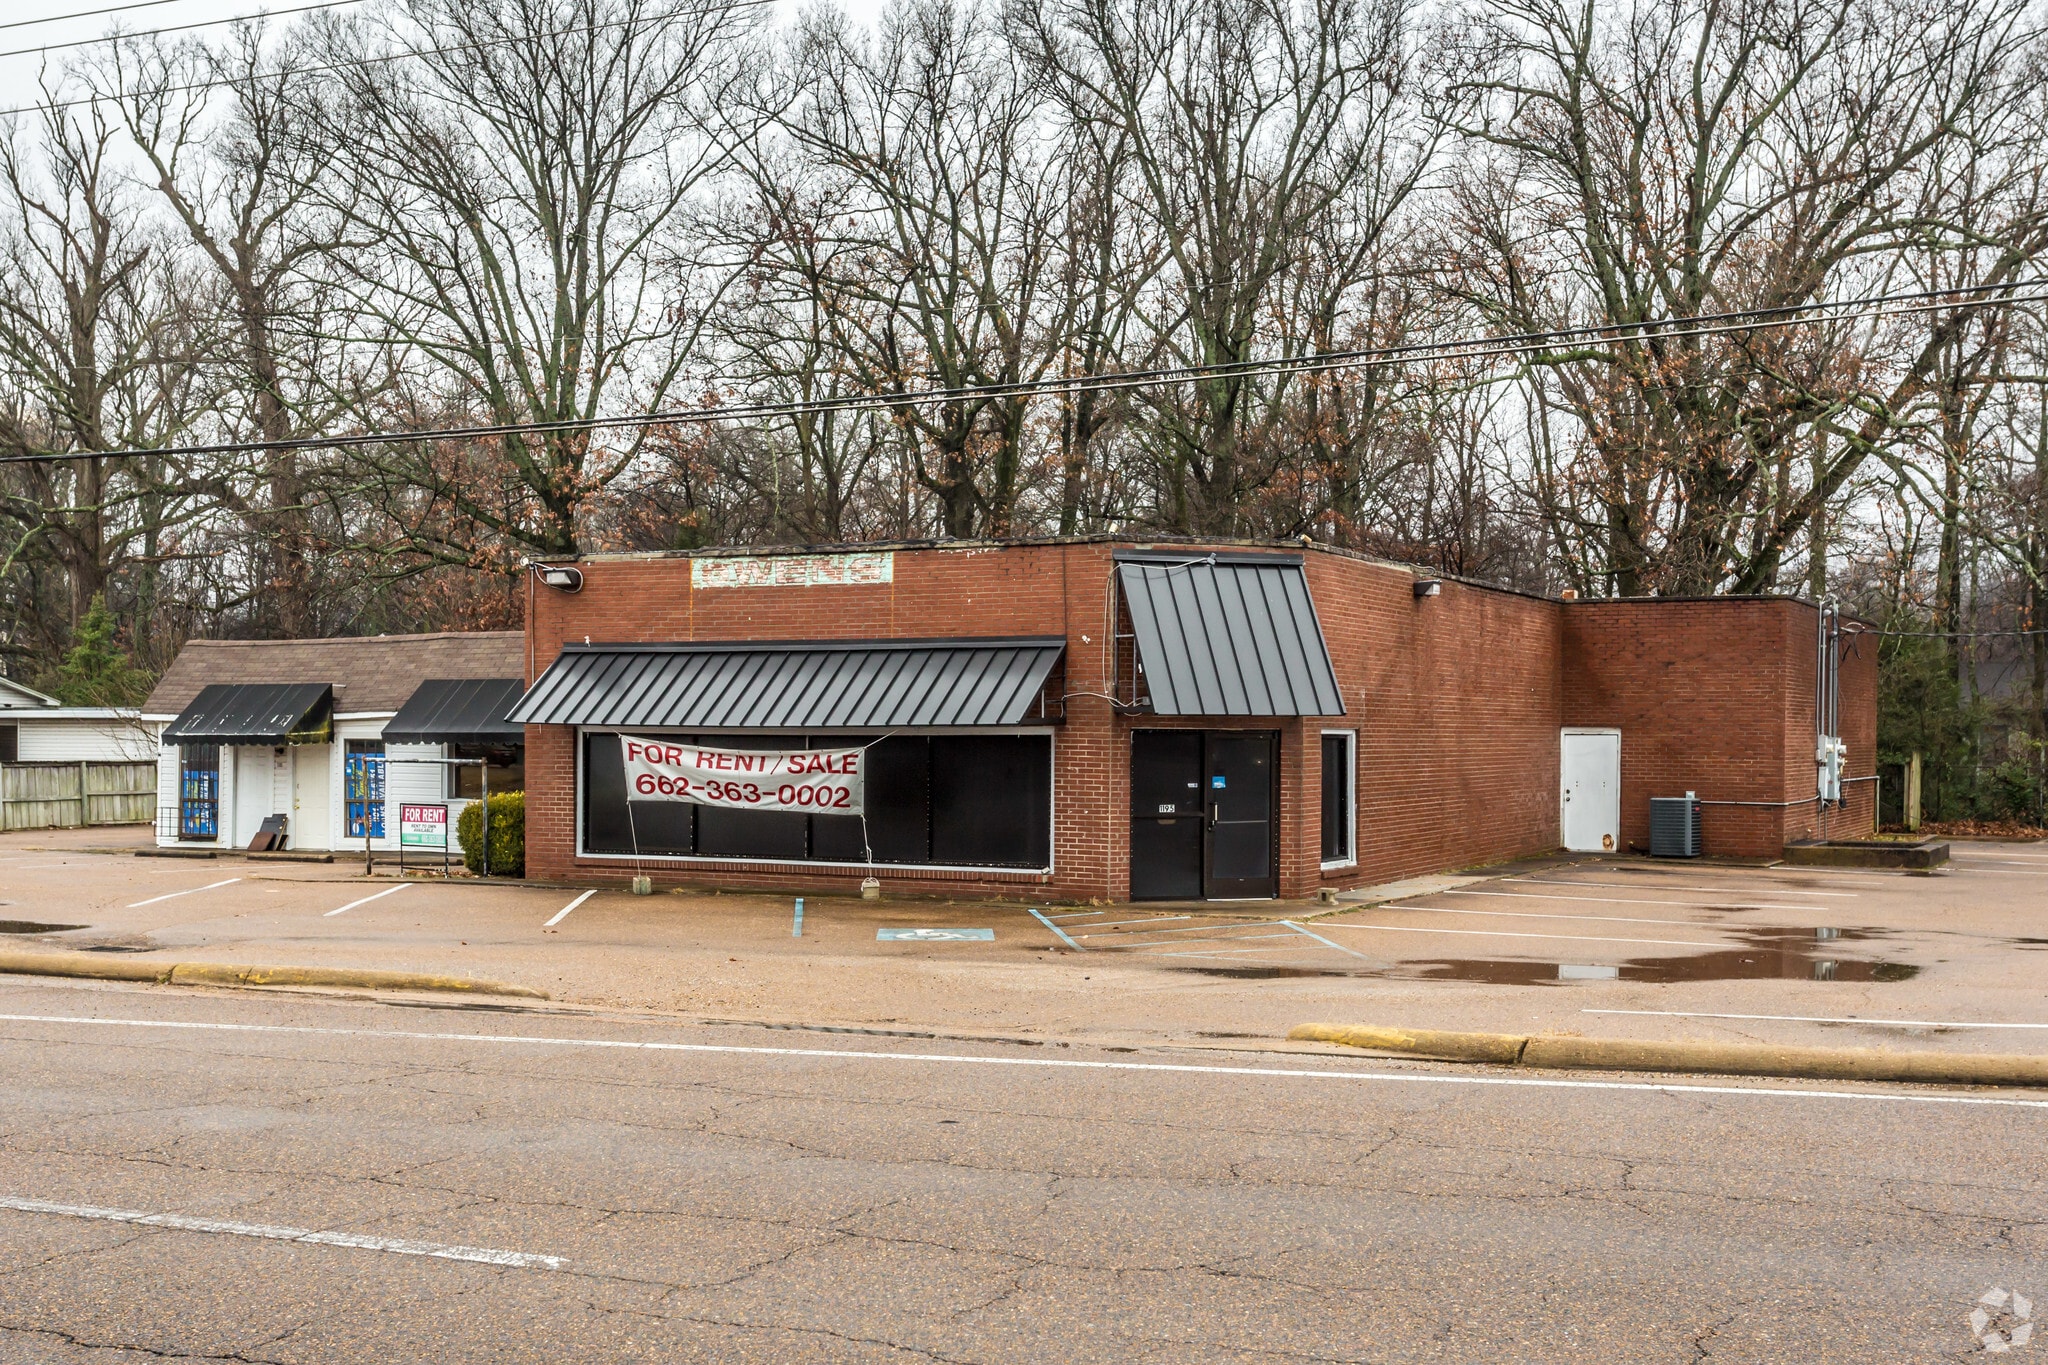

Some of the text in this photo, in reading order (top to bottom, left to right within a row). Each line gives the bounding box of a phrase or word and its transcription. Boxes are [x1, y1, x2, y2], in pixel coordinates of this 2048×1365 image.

[627, 742, 683, 767] FOR
[635, 773, 851, 809] 662-363-0002
[405, 808, 444, 822] FOR RENT
